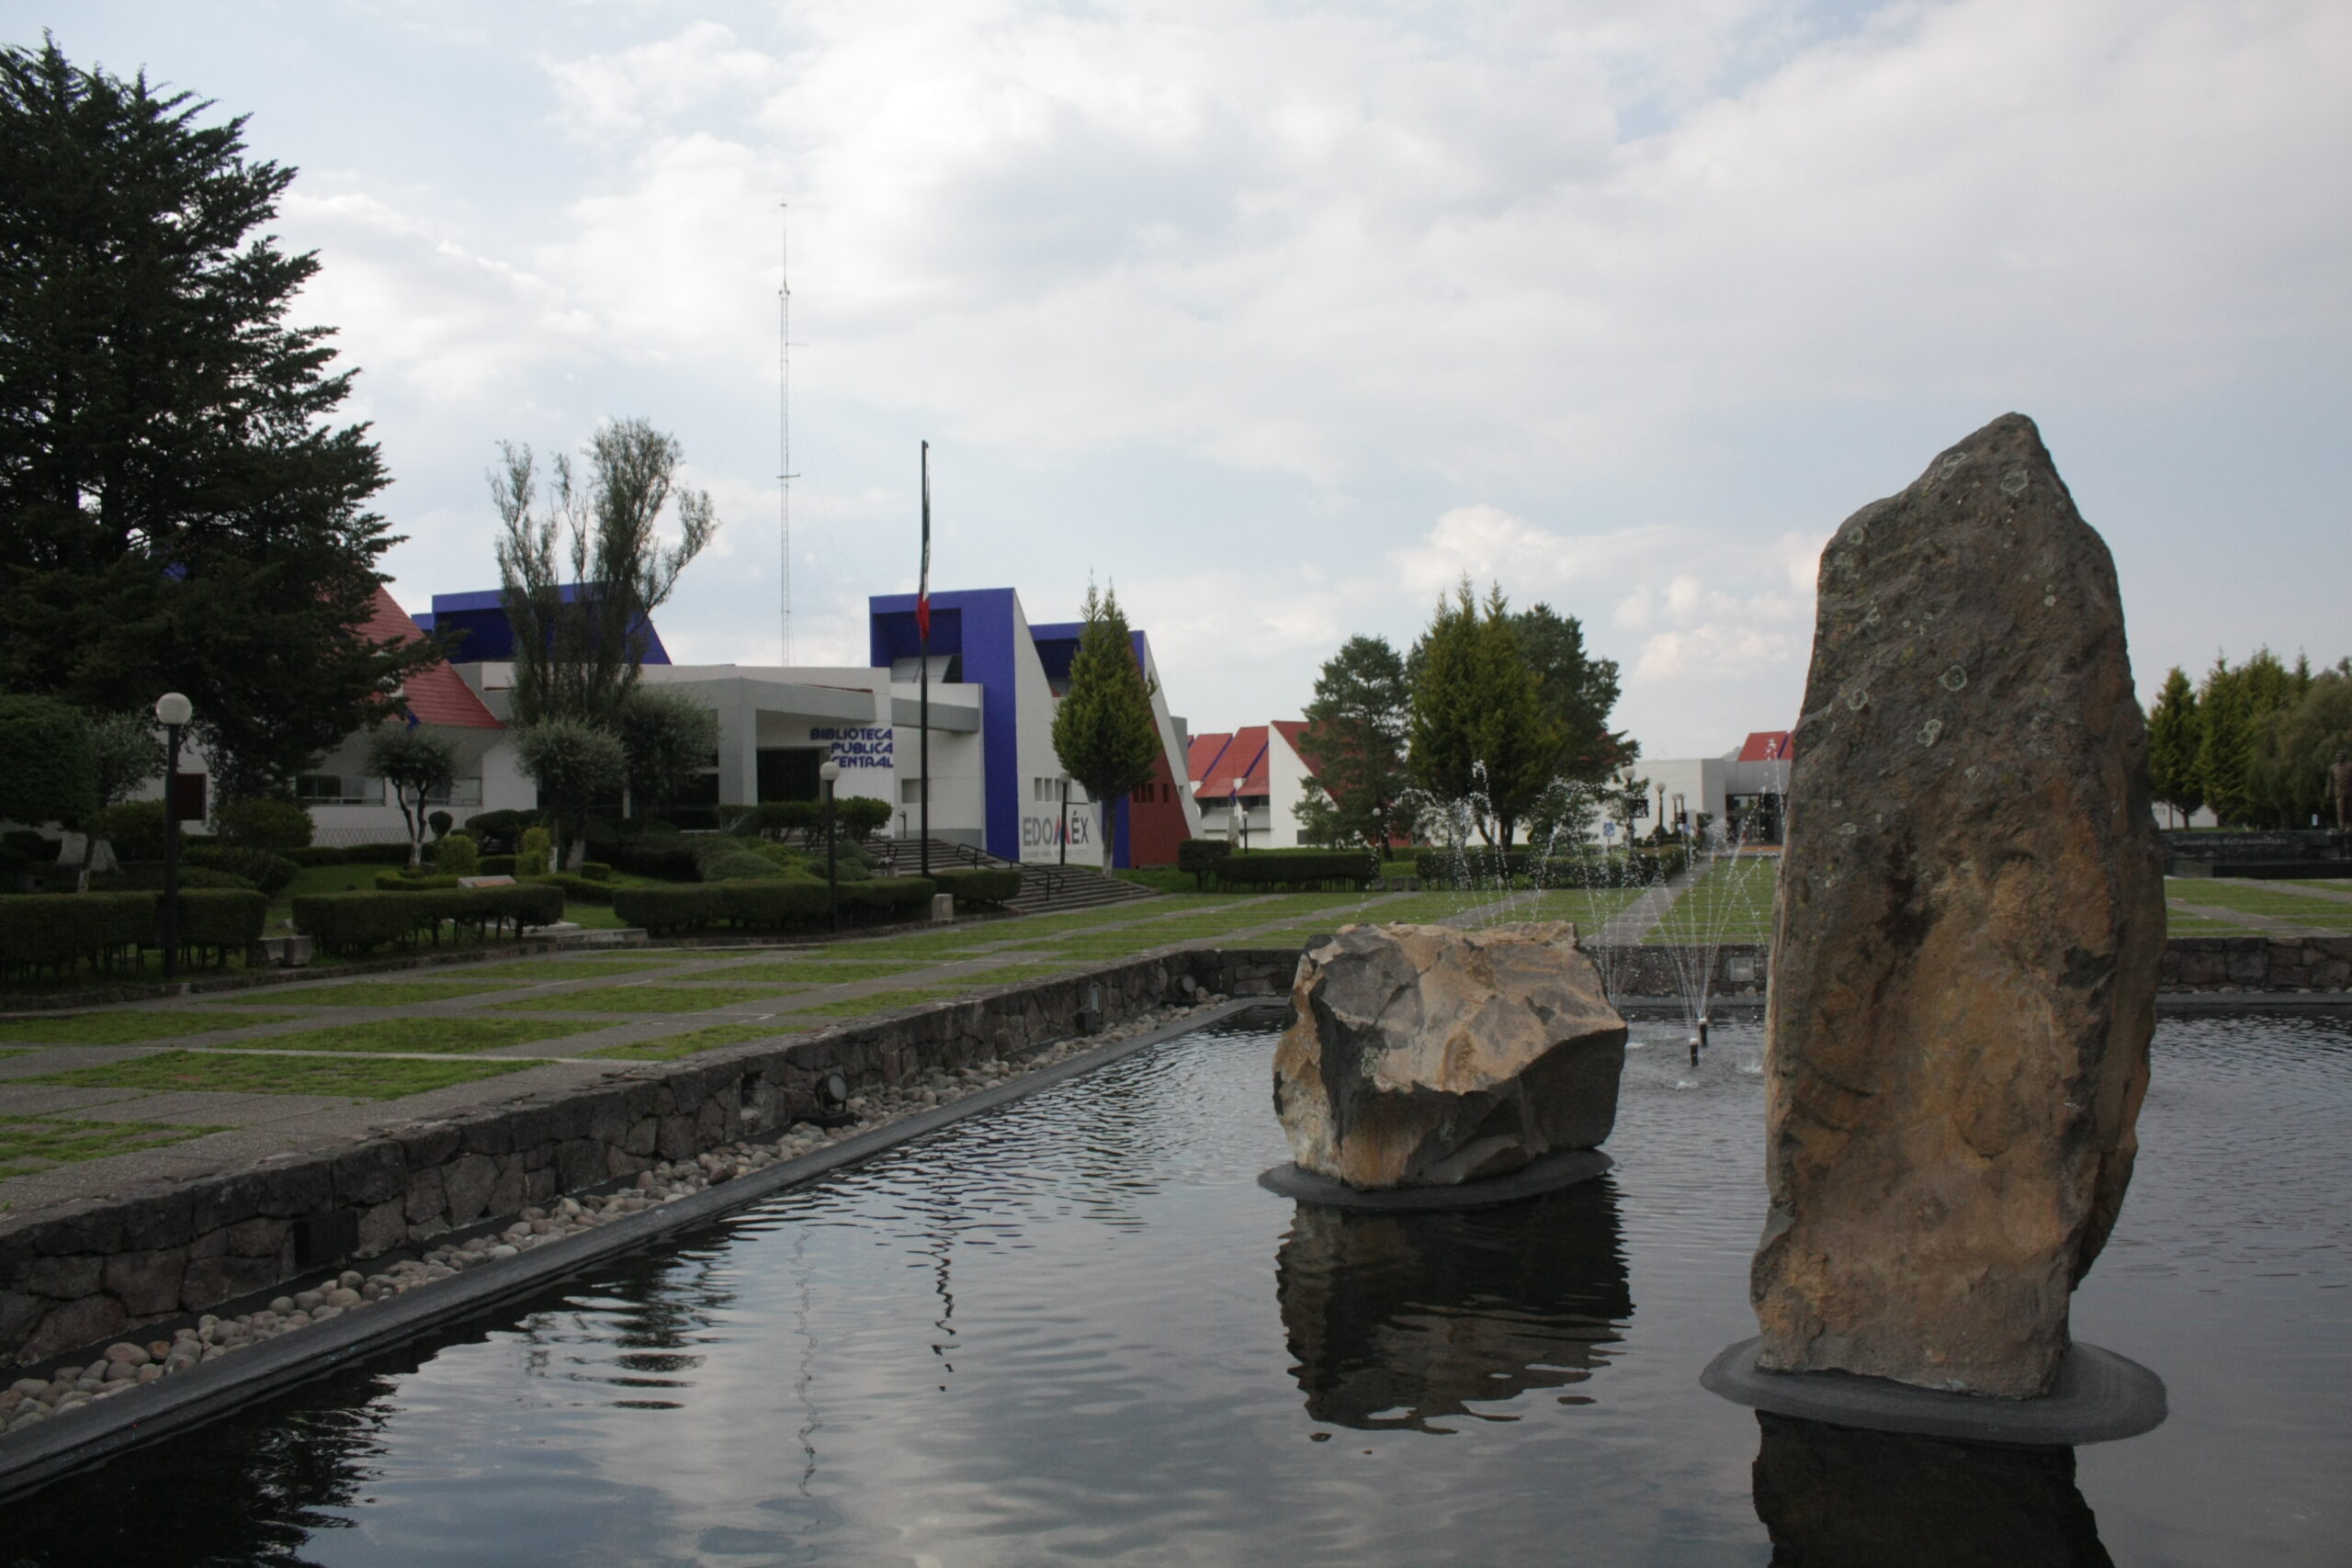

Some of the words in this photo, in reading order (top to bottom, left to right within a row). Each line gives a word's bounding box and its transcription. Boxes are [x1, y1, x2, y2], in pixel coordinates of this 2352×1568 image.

[810, 728, 893, 740] BIBLIOTECA
[831, 741, 893, 754] PUBLICA
[1023, 810, 1089, 846] EDOMÉX
